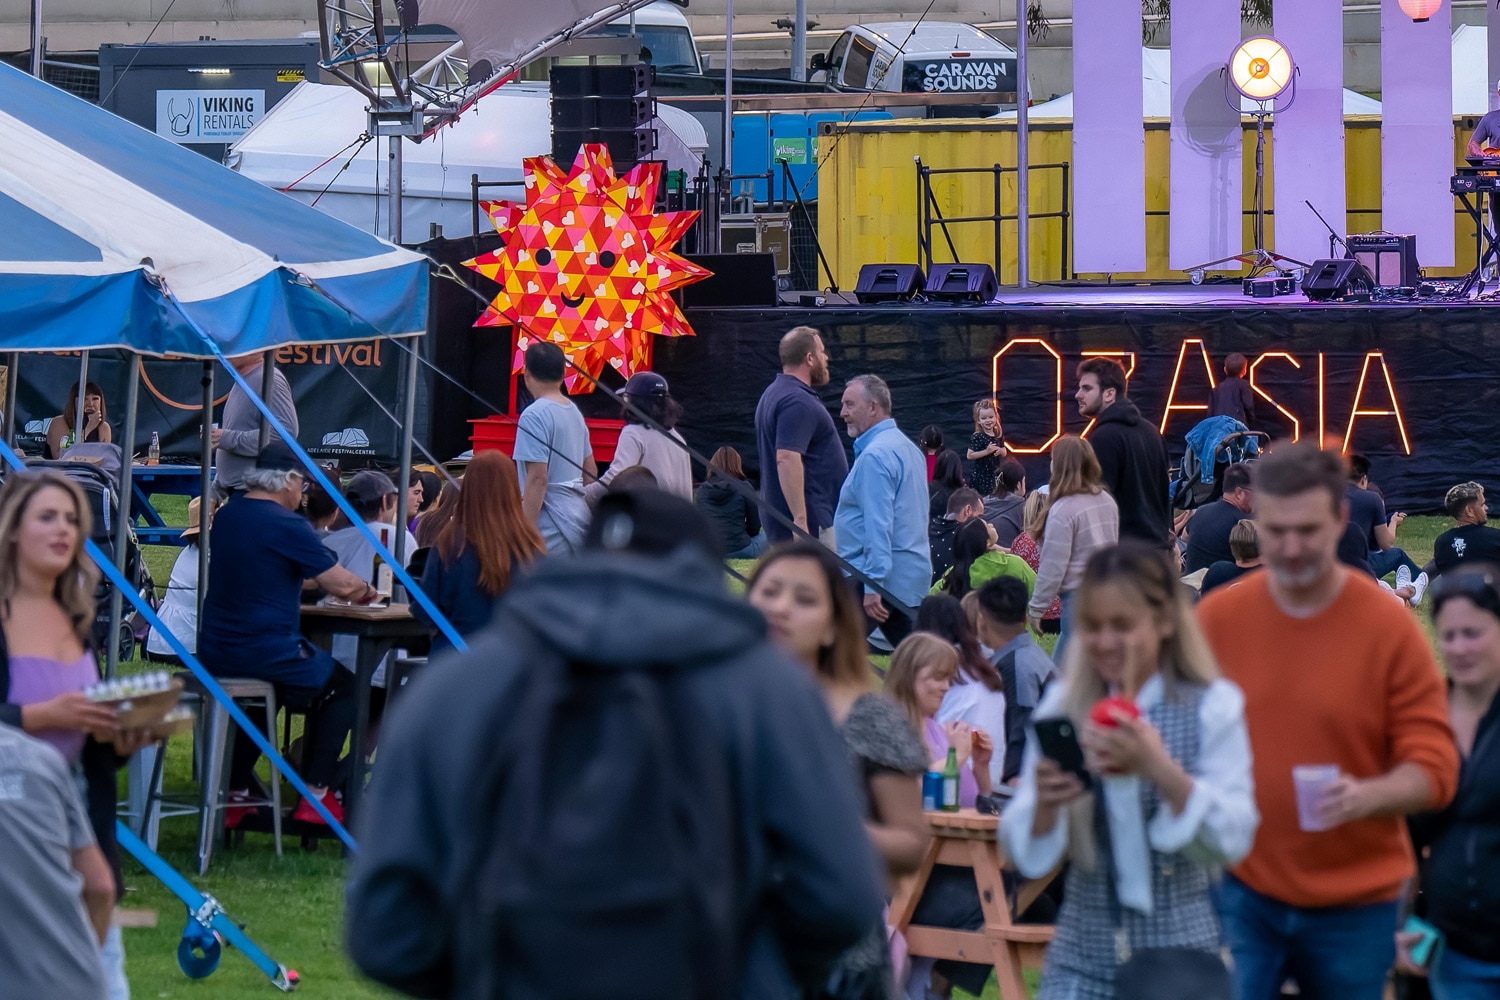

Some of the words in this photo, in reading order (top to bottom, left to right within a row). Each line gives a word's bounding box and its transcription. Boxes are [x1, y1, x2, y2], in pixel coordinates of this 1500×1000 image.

[924, 62, 1007, 77] CARAVAN
[923, 75, 998, 92] SOUNDS
[203, 97, 254, 113] VIKING
[203, 114, 254, 130] RENTALS
[274, 339, 382, 367] estival
